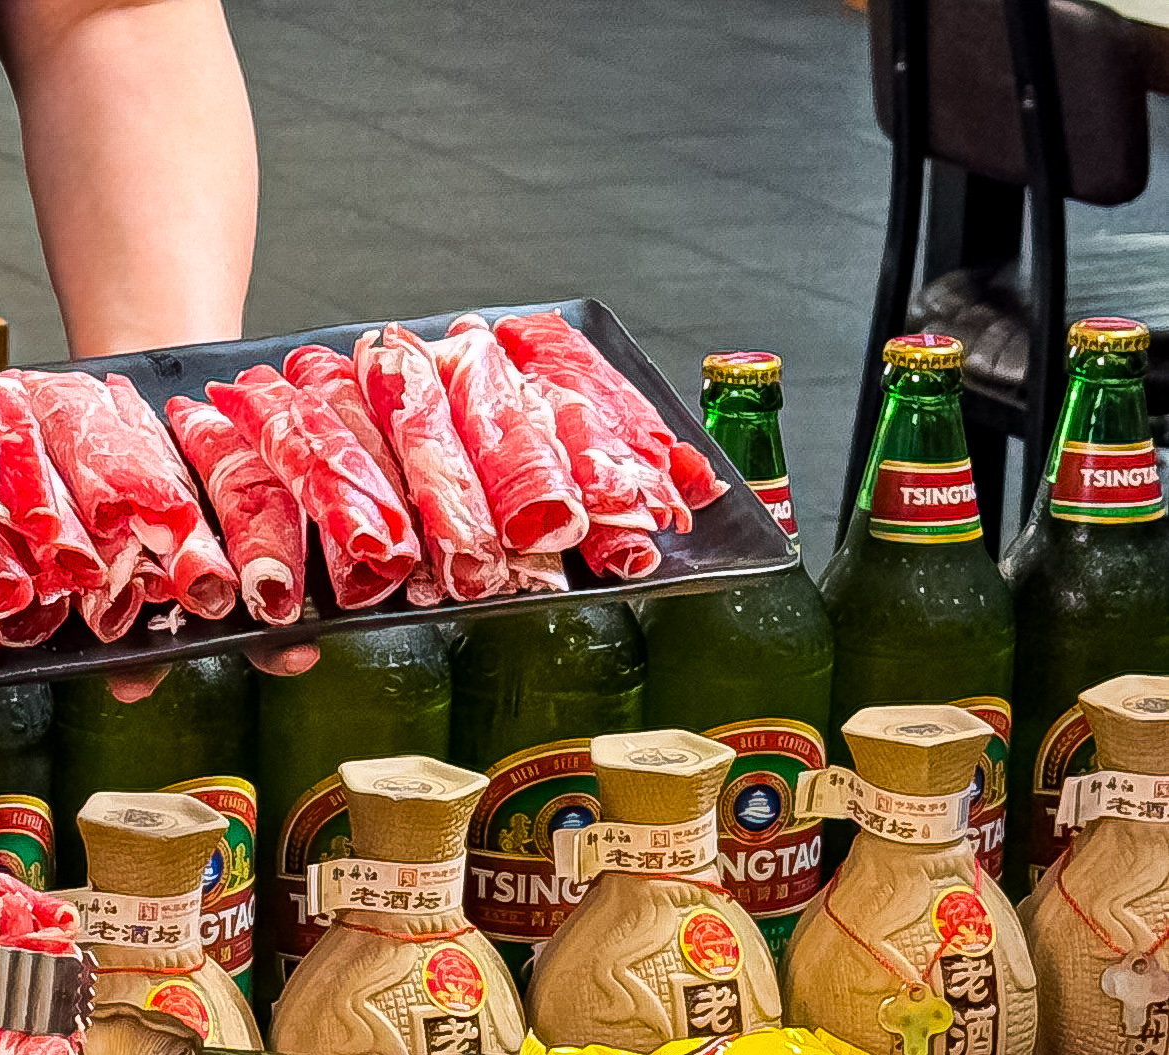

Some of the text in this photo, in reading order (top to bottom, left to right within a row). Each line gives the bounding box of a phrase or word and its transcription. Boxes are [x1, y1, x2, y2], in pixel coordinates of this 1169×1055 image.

[1106, 797, 1169, 819] 老酒
[605, 848, 695, 870] 老酒坛
[717, 835, 821, 881] NGTAO
[471, 866, 590, 905] TSING
[350, 887, 442, 910] 老酒坛
[88, 921, 181, 945] 老酒坛
[690, 985, 738, 1033] 老
